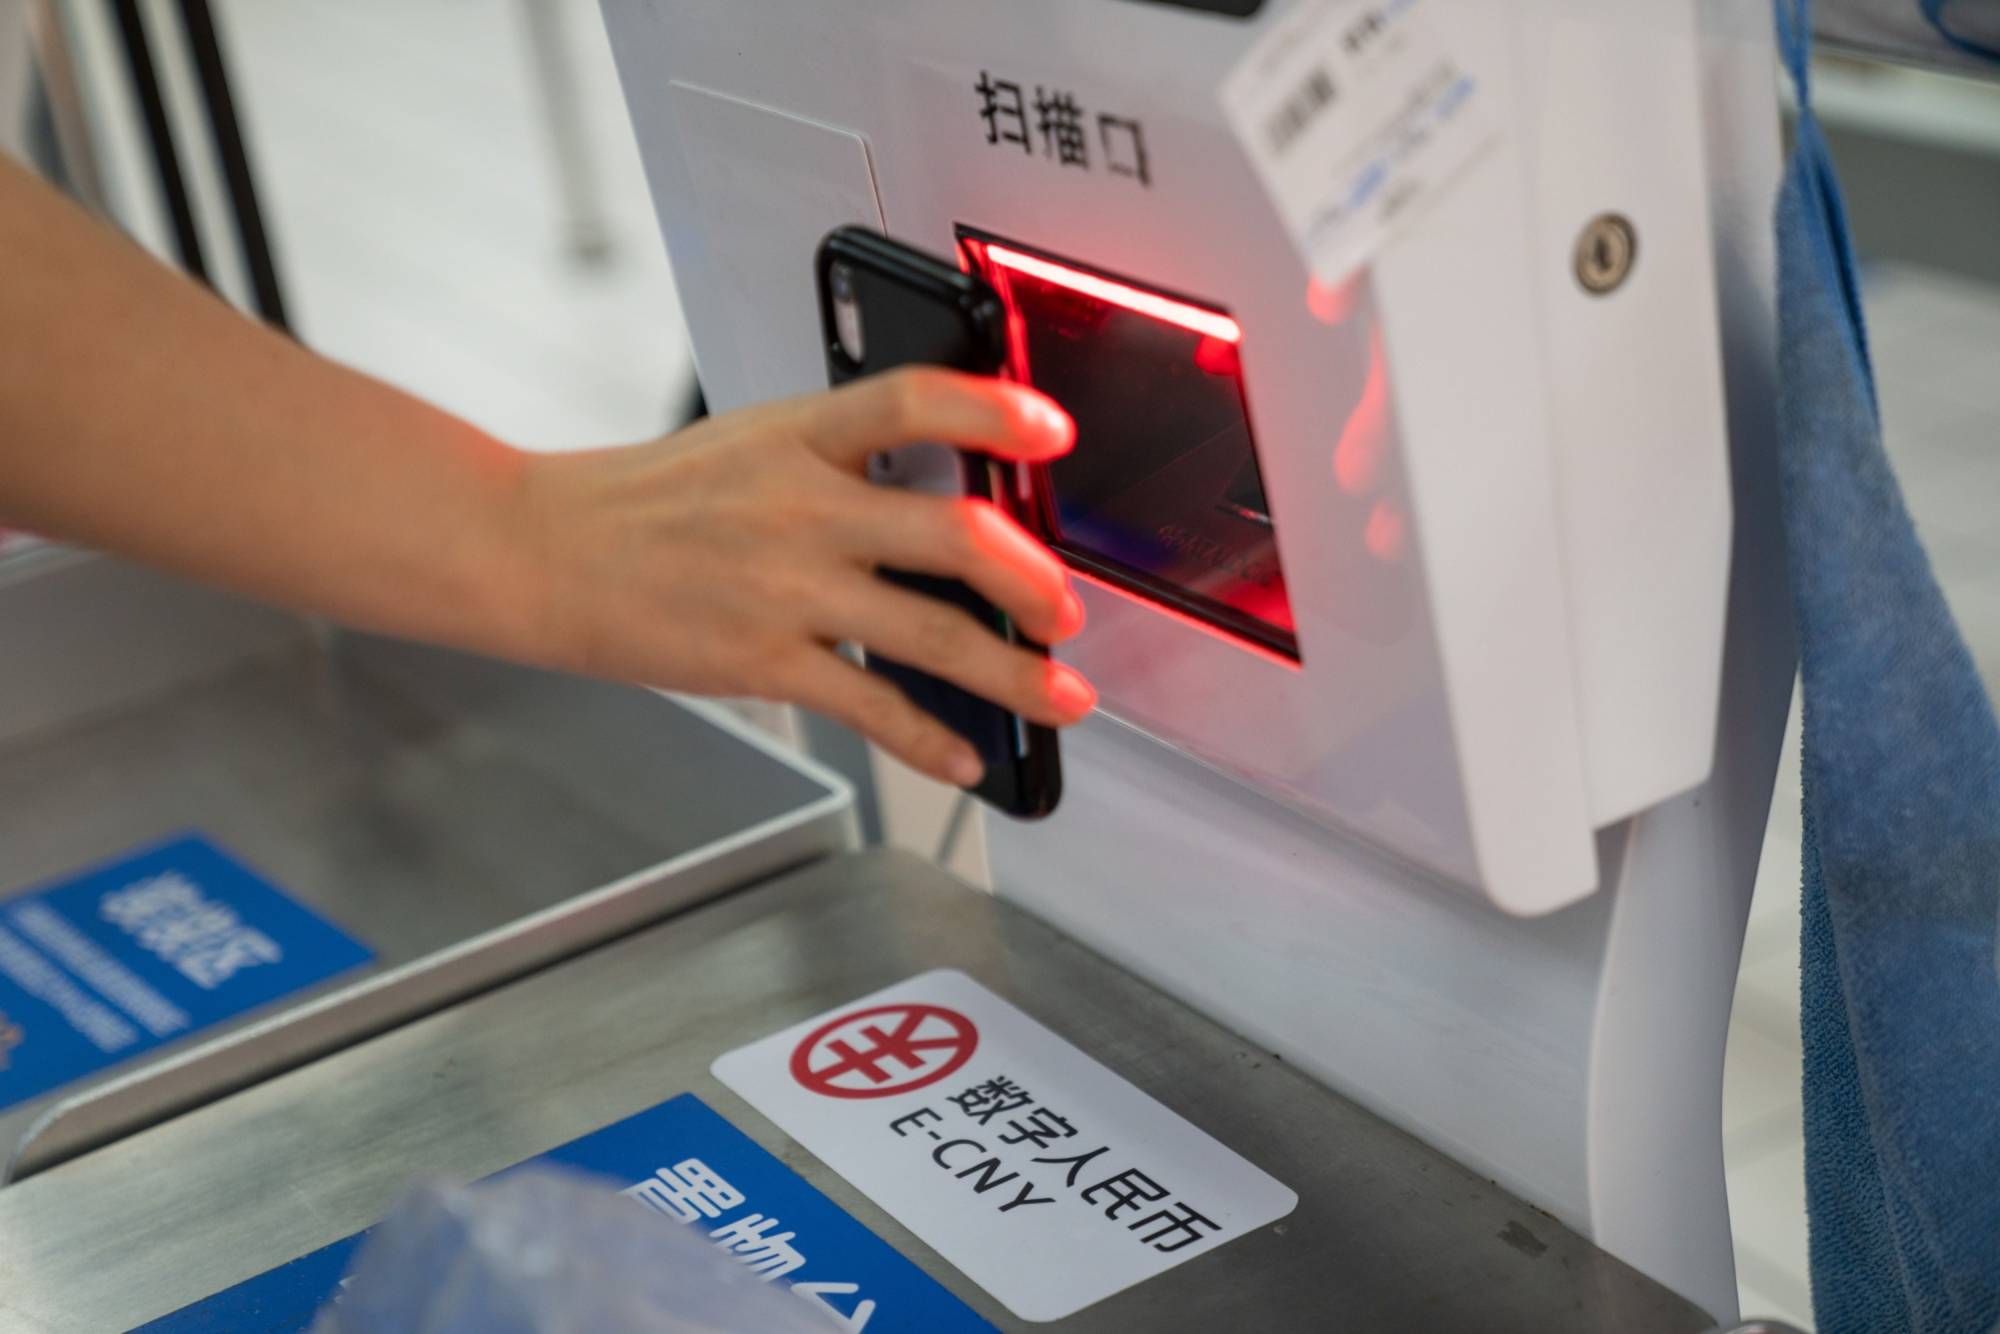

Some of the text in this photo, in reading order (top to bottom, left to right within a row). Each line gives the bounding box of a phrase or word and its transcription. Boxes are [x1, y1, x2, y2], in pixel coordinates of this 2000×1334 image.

[975, 70, 1152, 188] 扫描口
[888, 1106, 1056, 1214] E-CNY
[946, 1075, 1222, 1254] 数字人民币
